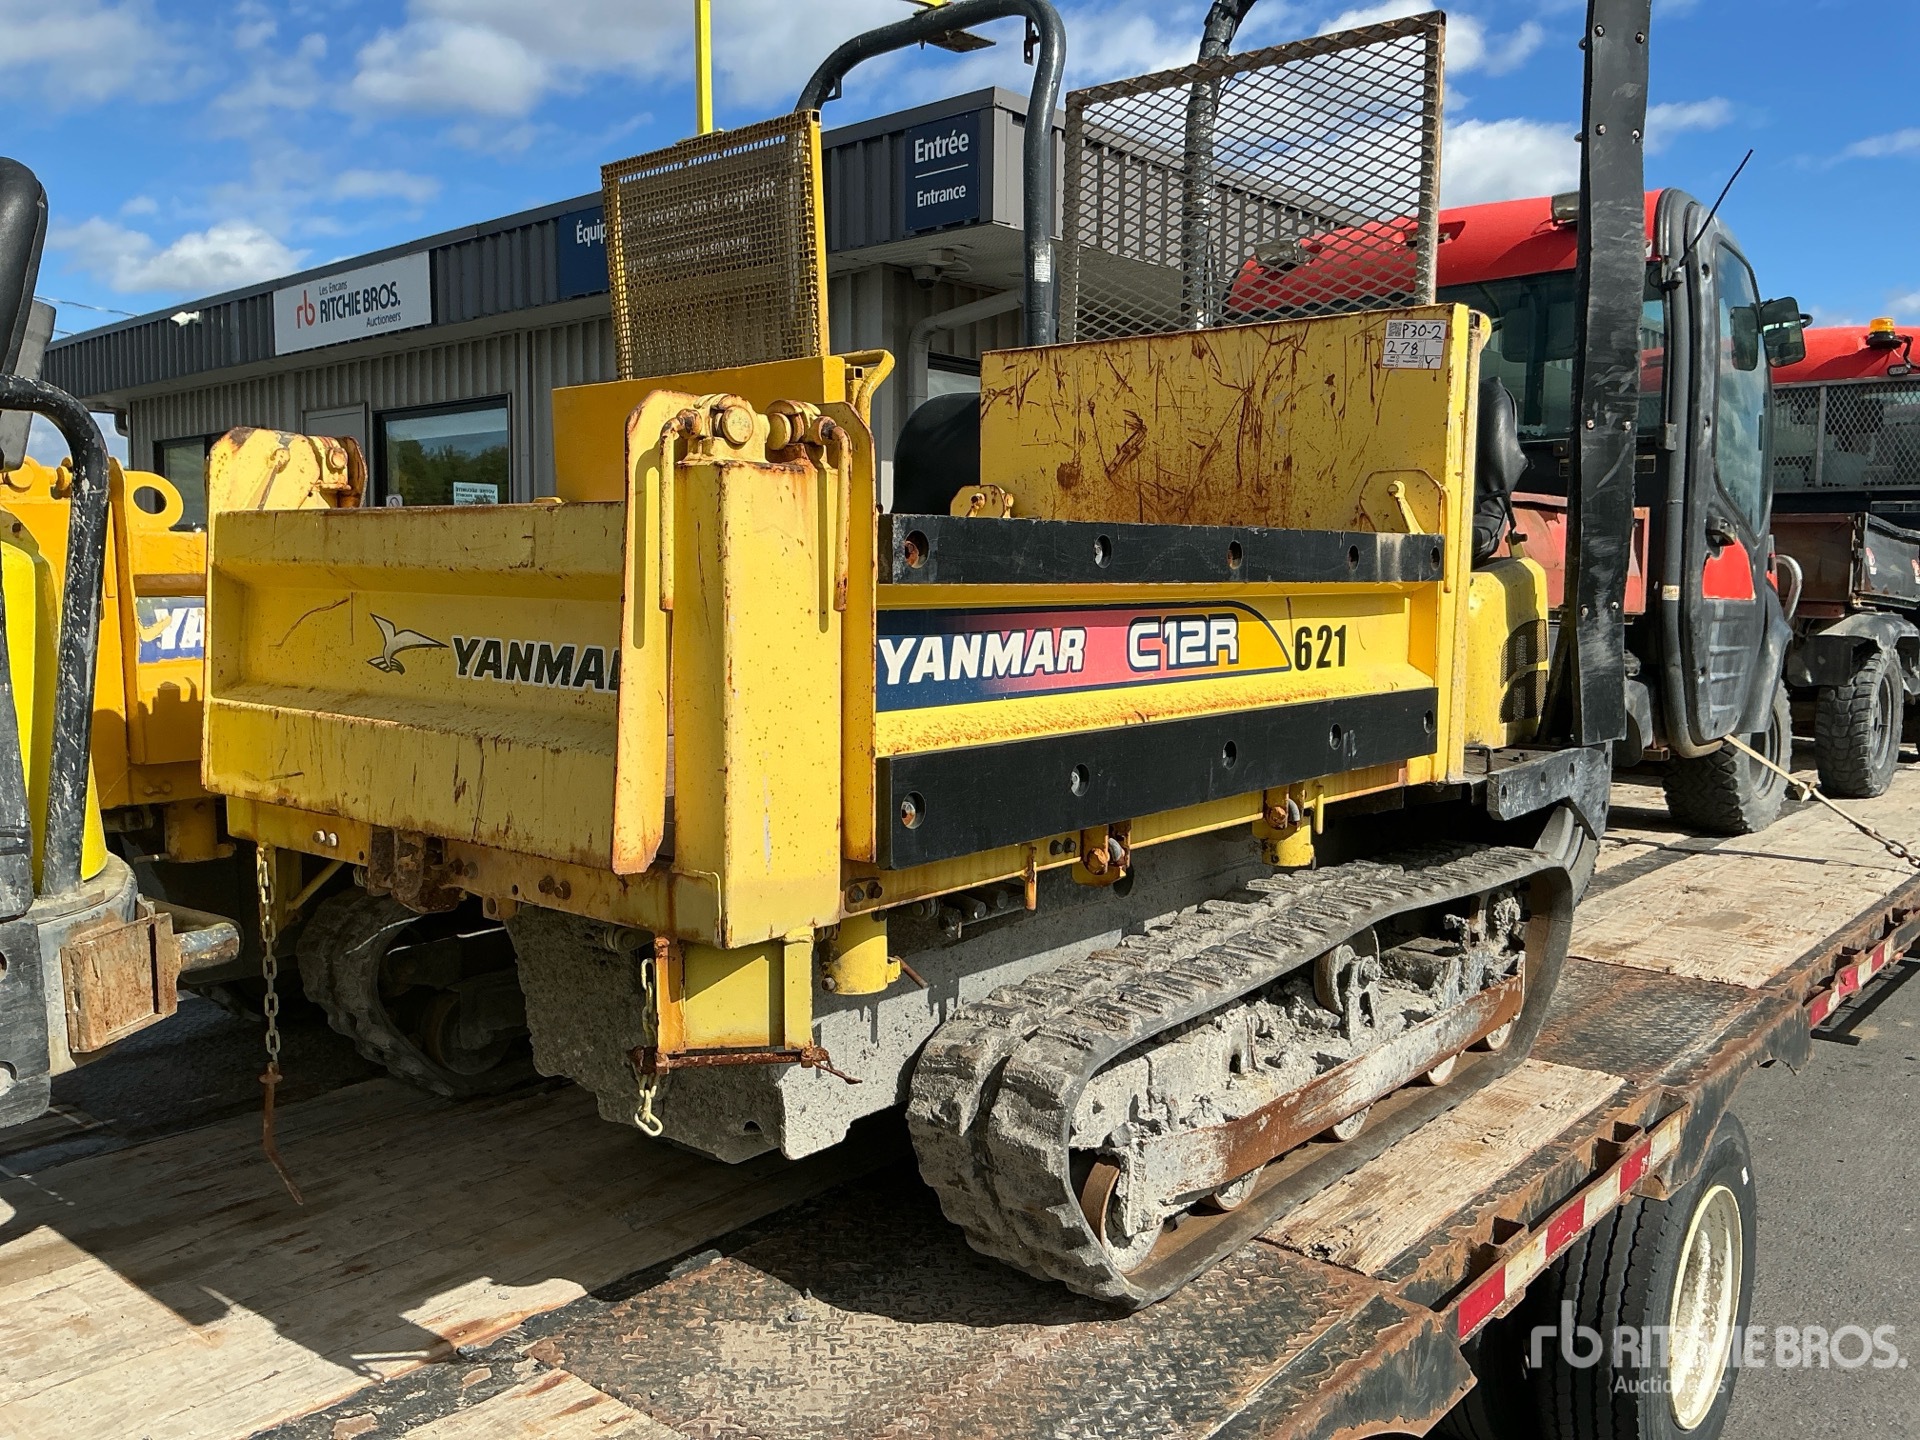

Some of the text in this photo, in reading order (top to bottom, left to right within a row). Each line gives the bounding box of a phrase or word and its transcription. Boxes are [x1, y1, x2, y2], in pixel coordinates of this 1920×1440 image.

[914, 129, 970, 164] Entrée
[916, 185, 967, 208] Entrance
[576, 219, 607, 248] Équip
[318, 281, 348, 296] Les Encans
[320, 281, 401, 323] RITCHIE BROS.
[296, 289, 316, 329] rb
[366, 311, 402, 328] Auctioneers
[1402, 323, 1442, 340] P30-2
[1386, 340, 1419, 356] 278
[877, 614, 1240, 685] YANMAR C12R
[1294, 624, 1347, 671] 621
